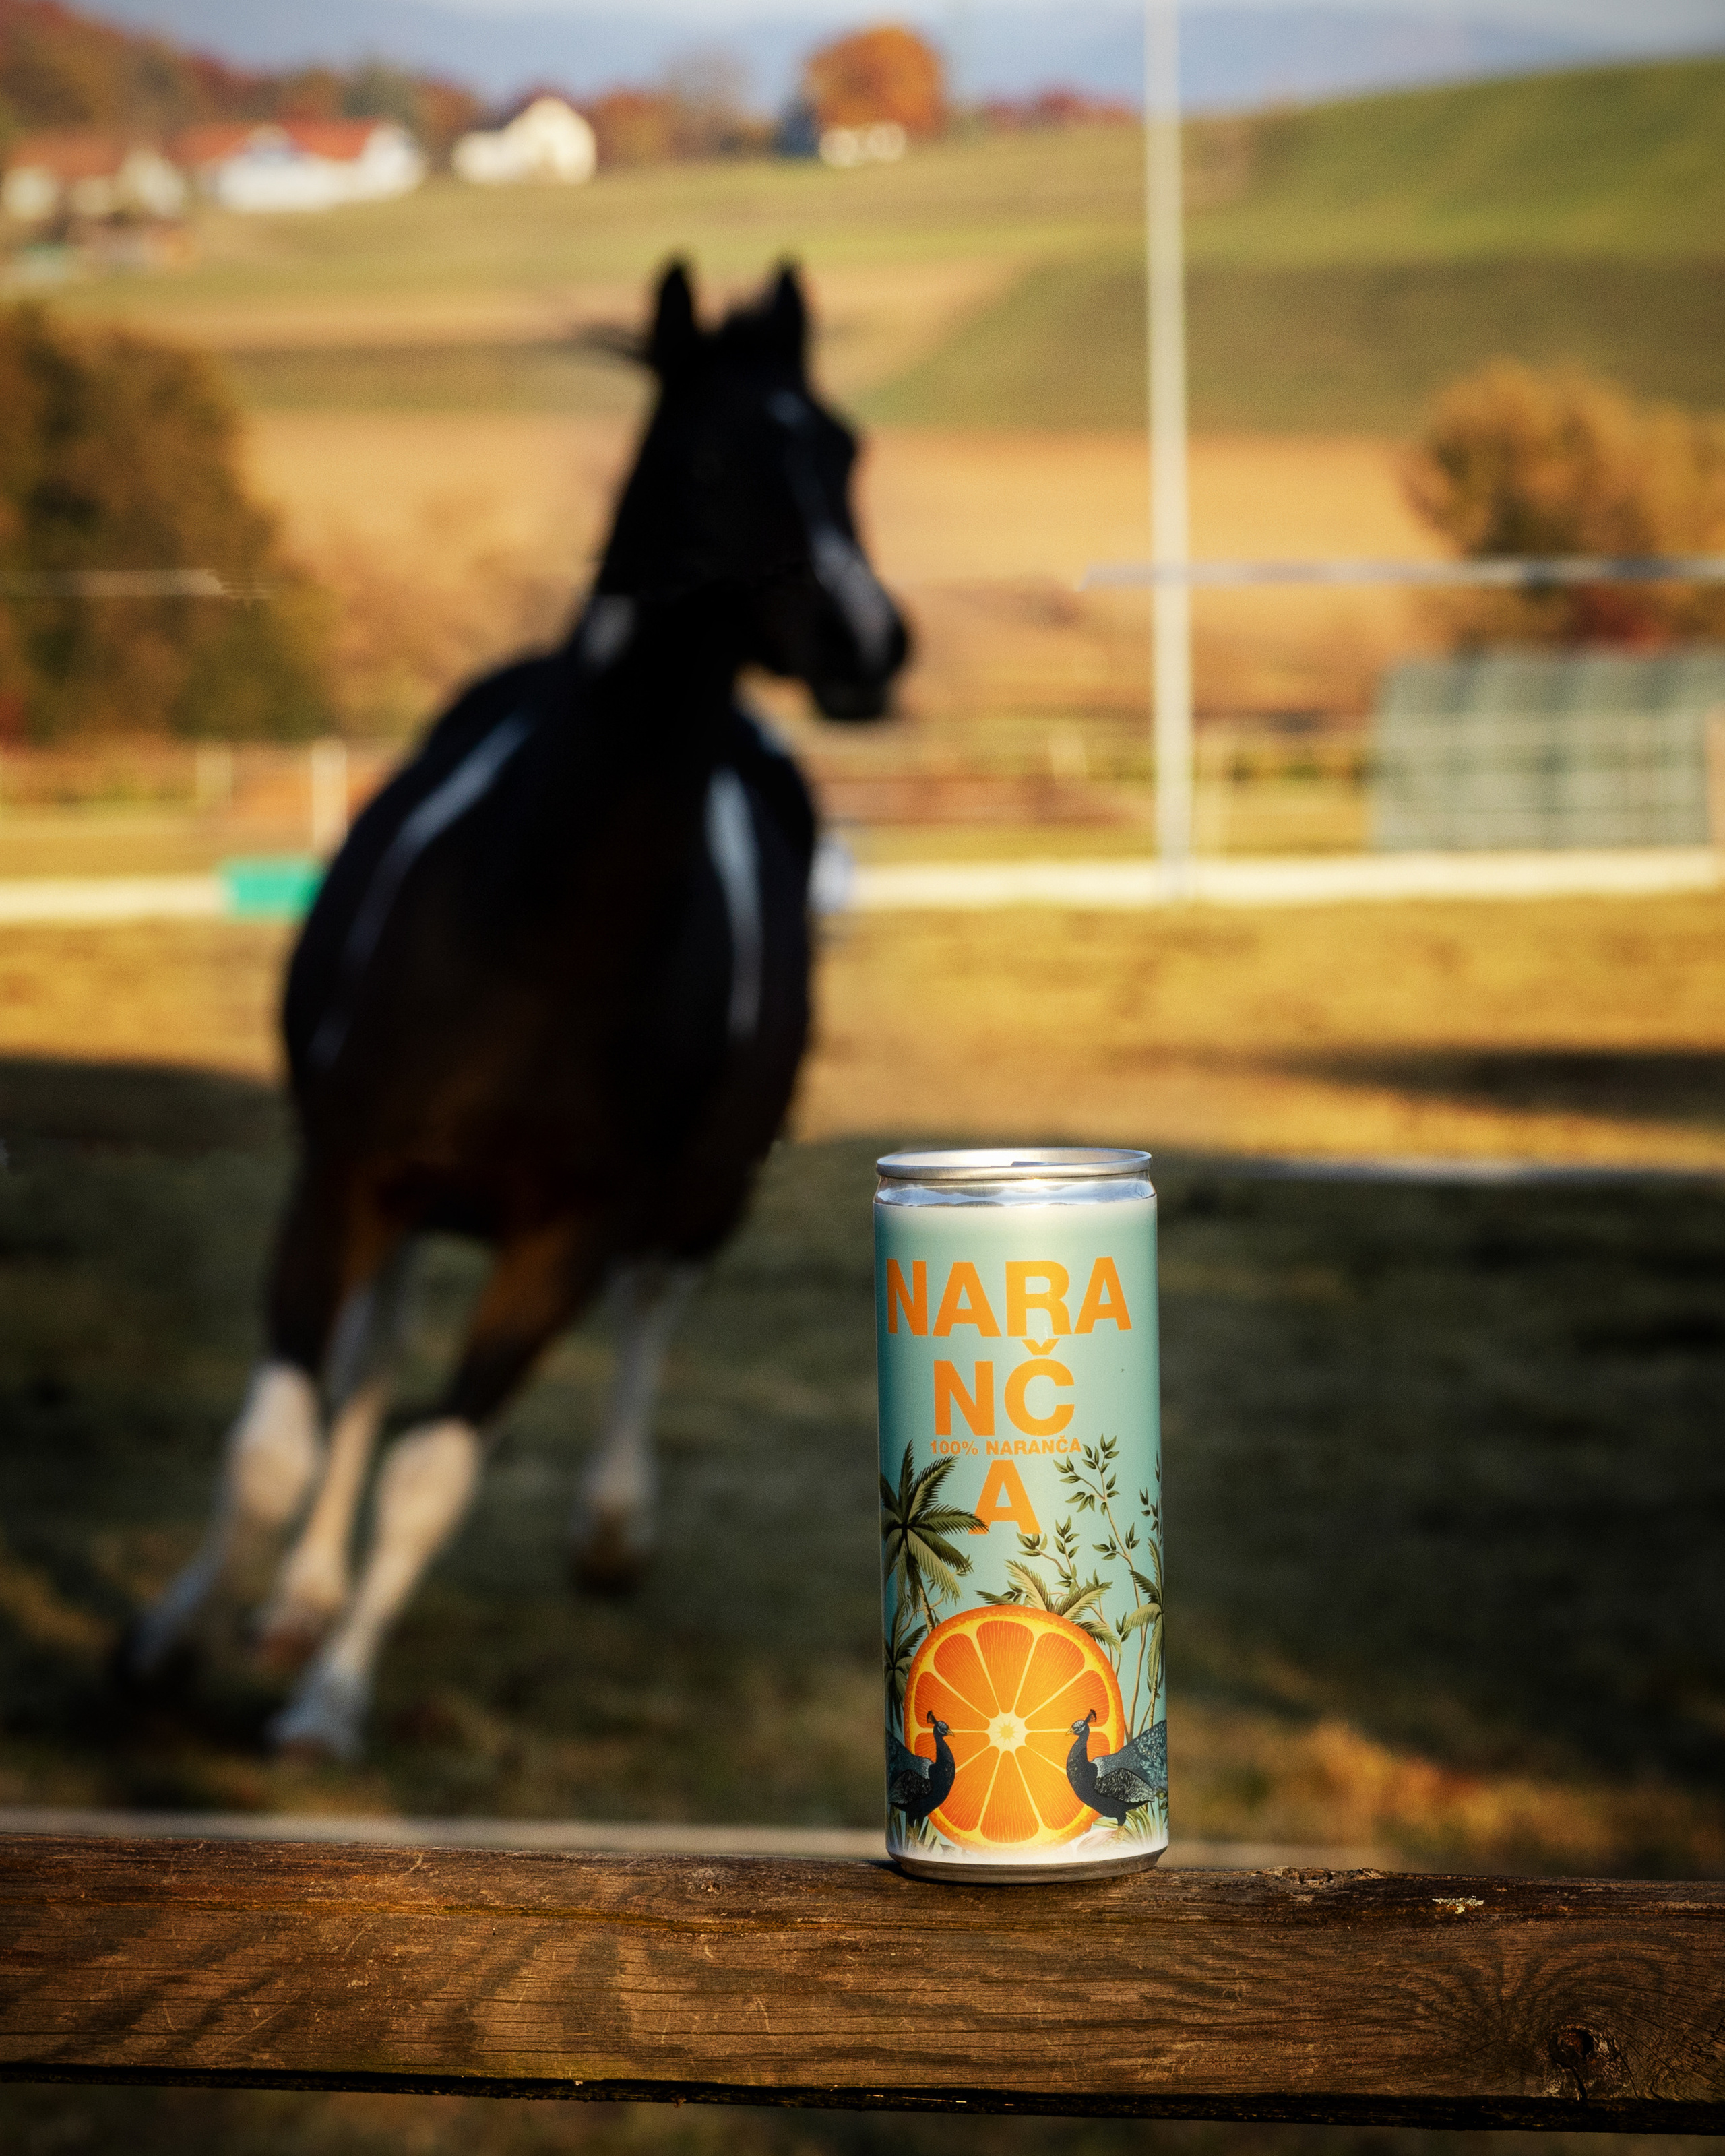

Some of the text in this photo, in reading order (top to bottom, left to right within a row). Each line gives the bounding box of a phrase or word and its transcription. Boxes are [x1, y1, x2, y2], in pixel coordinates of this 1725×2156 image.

[886, 1256, 1133, 1337] NARA
[933, 1337, 1076, 1437] NČ
[929, 1434, 1082, 1456] 100% NARANČA
[968, 1459, 1042, 1535] A
